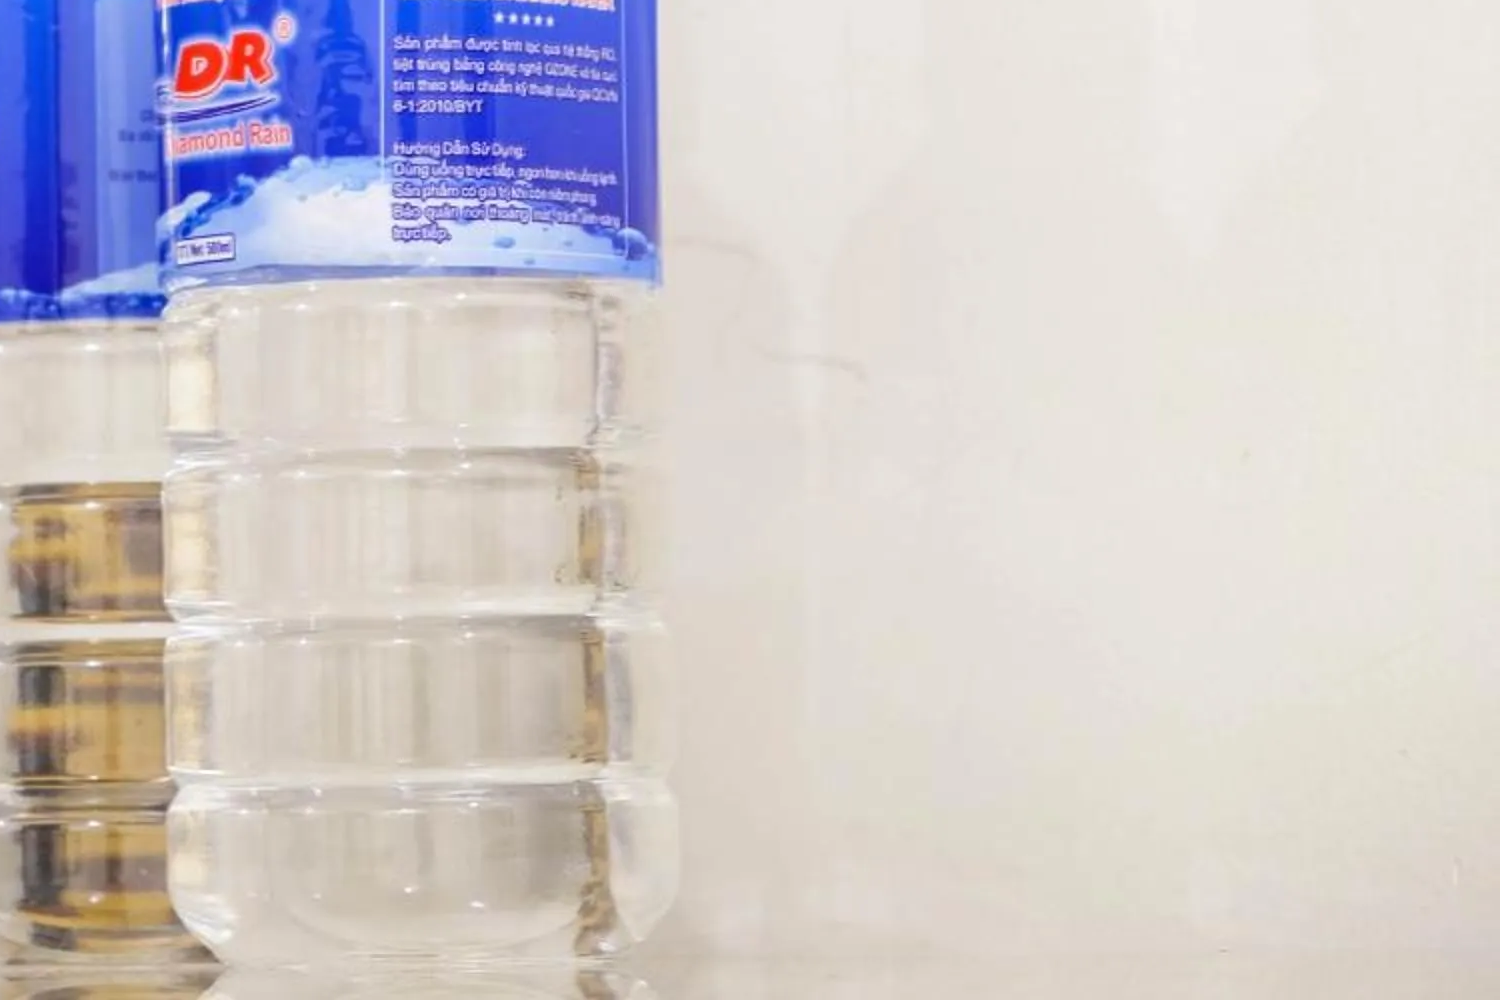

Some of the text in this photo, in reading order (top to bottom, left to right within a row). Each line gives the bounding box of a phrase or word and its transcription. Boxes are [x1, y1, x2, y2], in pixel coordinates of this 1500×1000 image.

[394, 34, 420, 50] Sản
[424, 33, 462, 53] phẩm
[173, 30, 276, 98] DR
[167, 124, 246, 158] iamond
[249, 120, 292, 148] Rain
